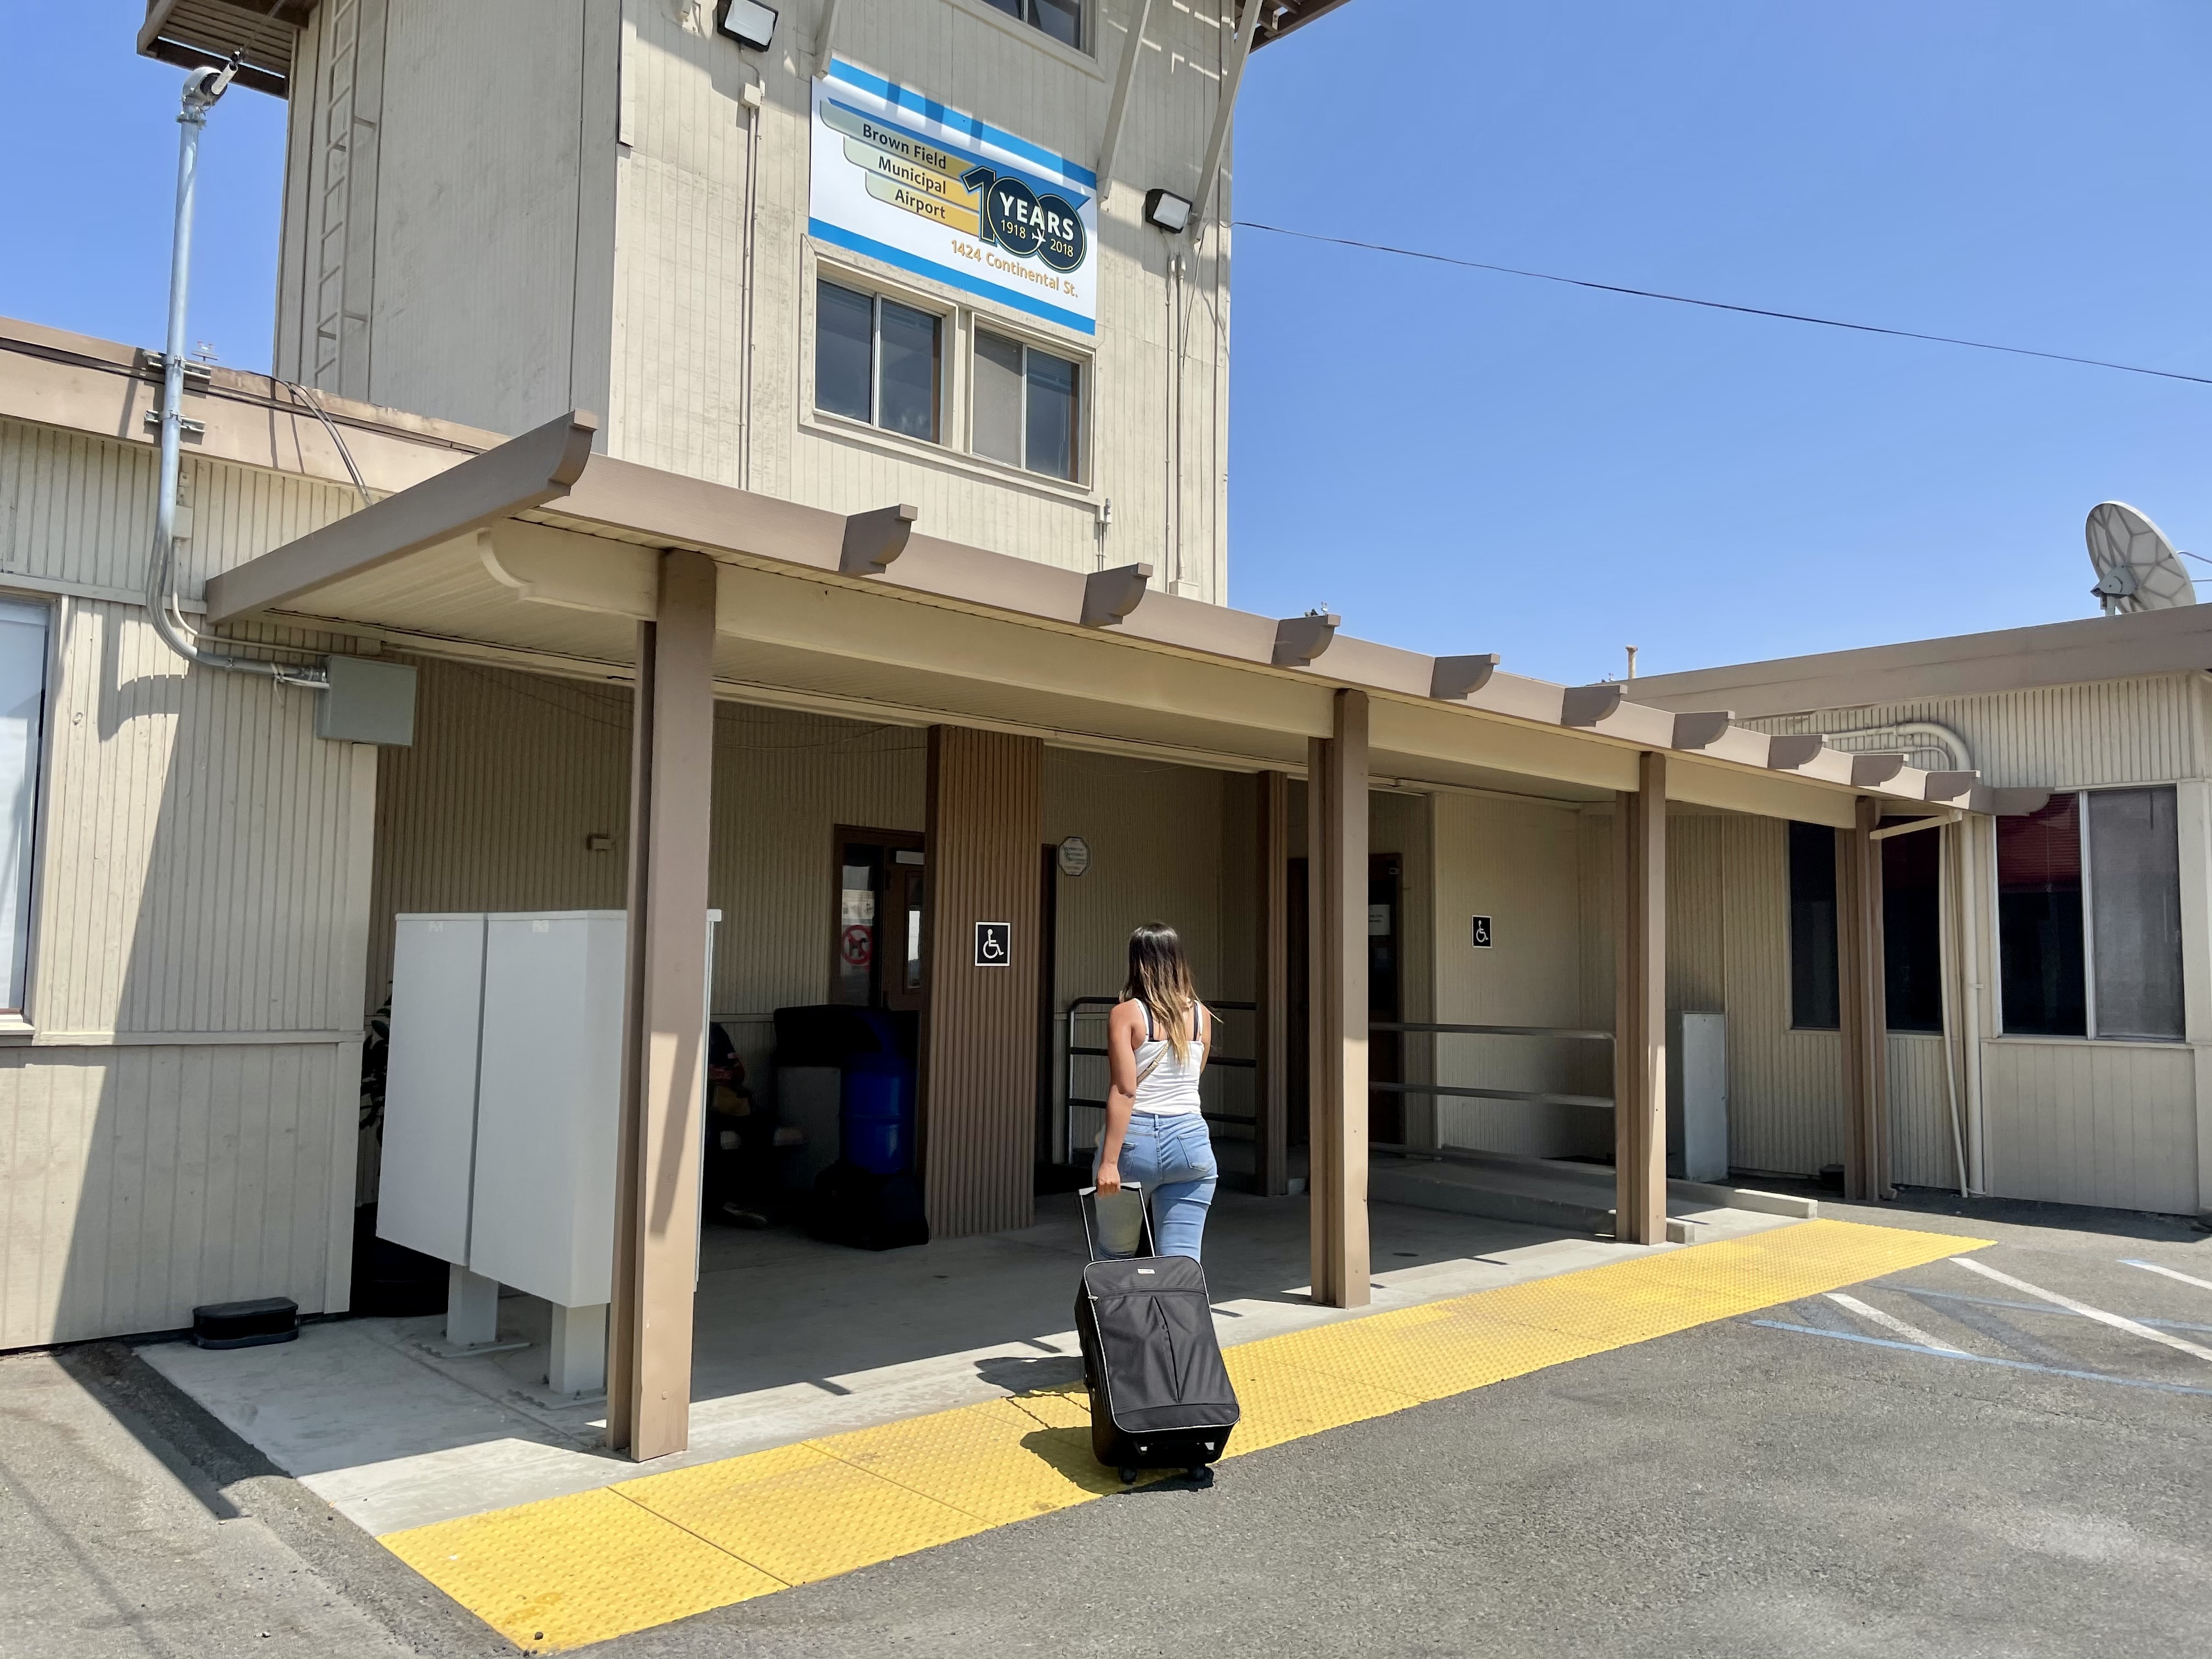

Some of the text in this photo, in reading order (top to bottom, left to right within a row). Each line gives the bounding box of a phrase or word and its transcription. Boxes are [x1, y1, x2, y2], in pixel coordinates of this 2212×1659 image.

[863, 123, 946, 170] Brown Field
[878, 155, 946, 194] Municipal
[895, 188, 946, 219] Airport
[999, 191, 1074, 241] YEARS
[1001, 219, 1026, 239] 1918
[1050, 239, 1074, 258] 2018
[951, 239, 1078, 298] 1424 Continental St.
